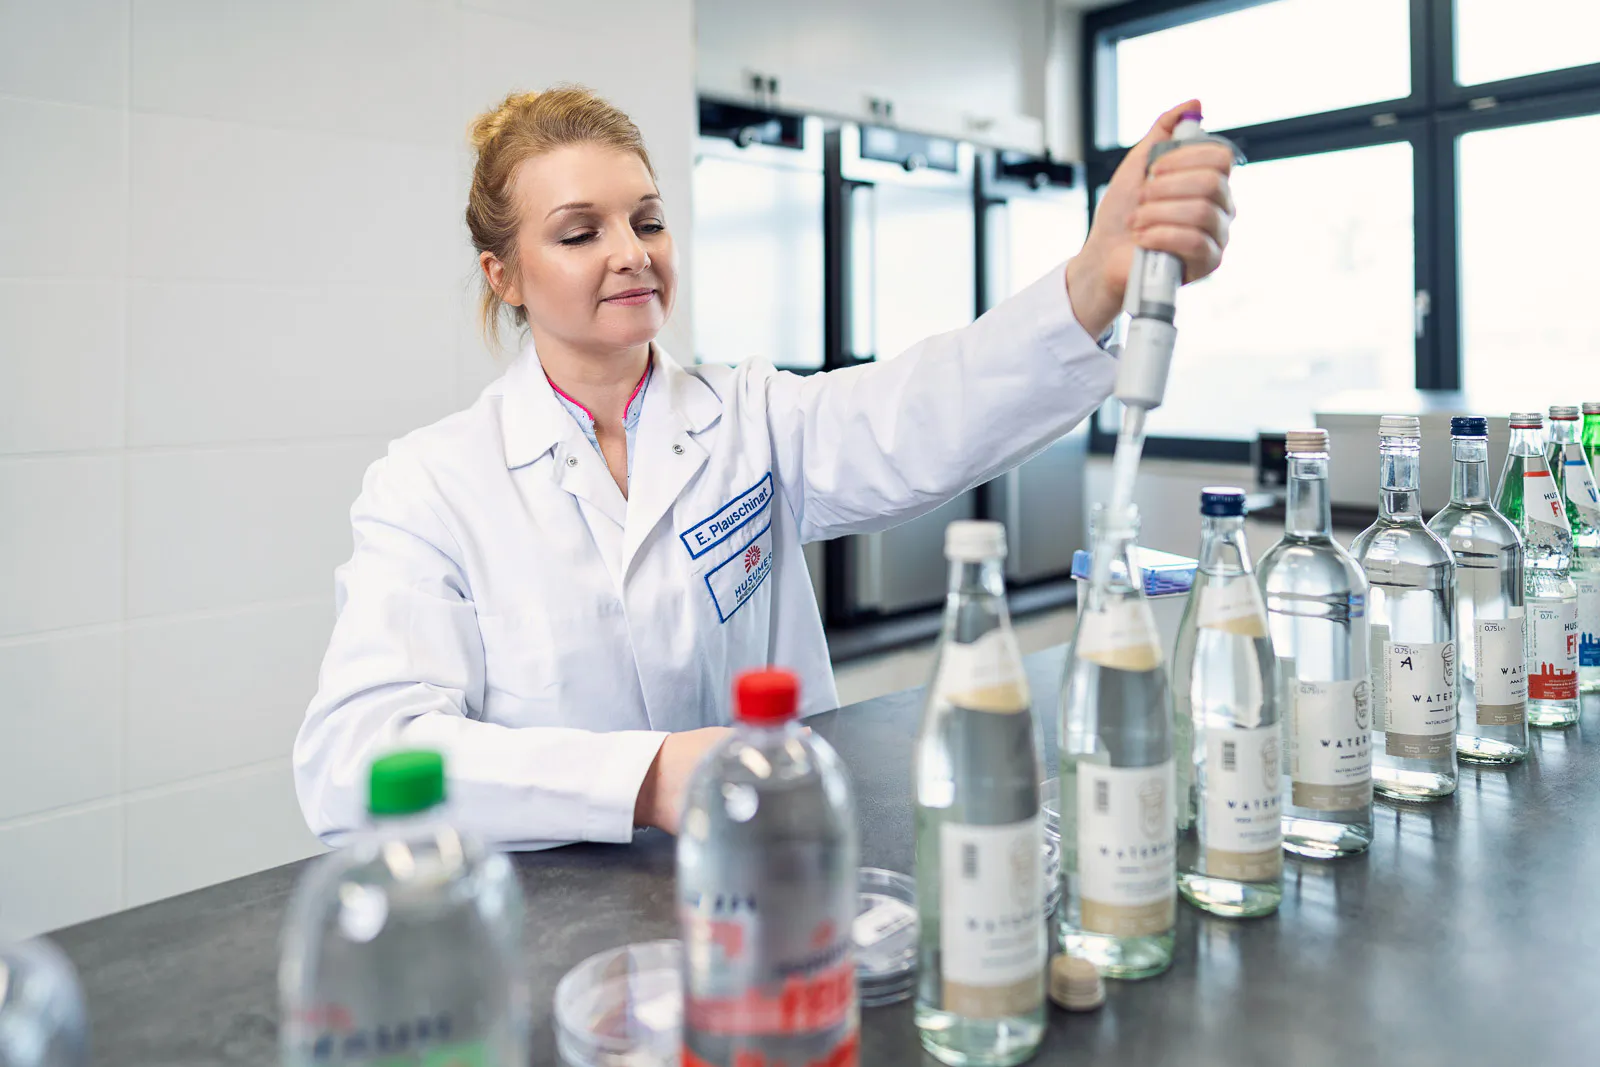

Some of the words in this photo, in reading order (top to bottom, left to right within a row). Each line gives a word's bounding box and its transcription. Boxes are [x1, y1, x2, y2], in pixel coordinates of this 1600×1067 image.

[695, 531, 711, 546] E.
[709, 487, 768, 538] Plauschinat
[1400, 656, 1413, 670] A
